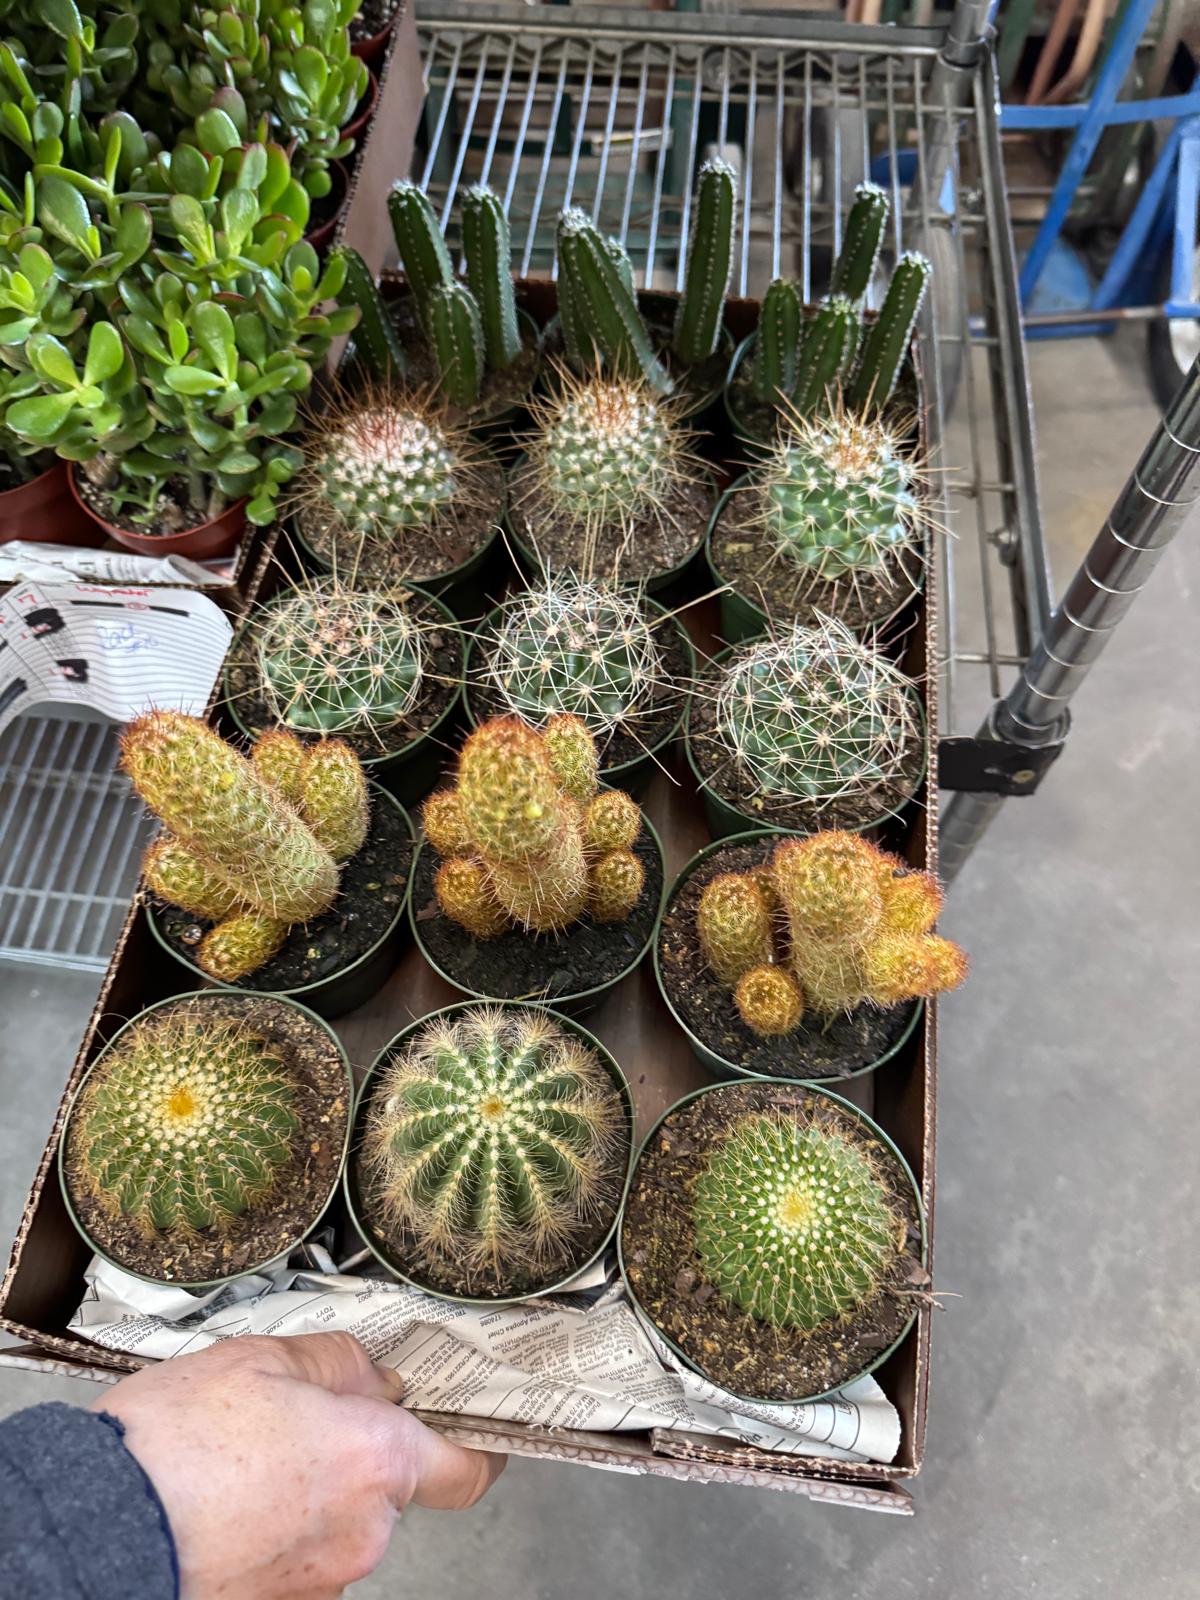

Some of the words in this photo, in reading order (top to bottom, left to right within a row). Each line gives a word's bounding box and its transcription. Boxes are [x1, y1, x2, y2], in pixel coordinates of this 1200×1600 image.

[380, 1299, 402, 1313] Florida
[422, 1303, 444, 1315] NORTH
[360, 1310, 381, 1324] statute
[378, 1306, 402, 1321] services
[392, 1307, 415, 1322] amount
[529, 1313, 539, 1322] The
[355, 1319, 378, 1335] charges
[390, 1312, 421, 1331] FORSYTH
[505, 1318, 528, 1332] Apopka
[540, 1319, 563, 1334] LIMITED
[126, 1329, 152, 1351] PUBLIC
[487, 1327, 504, 1339] Chief
[474, 1355, 488, 1370] West
[593, 1349, 613, 1362] County
[598, 1366, 627, 1379] INSTITUTE
[626, 1366, 647, 1375] DIGITAL
[518, 1398, 530, 1411] Auto
[584, 1401, 600, 1418] Public
